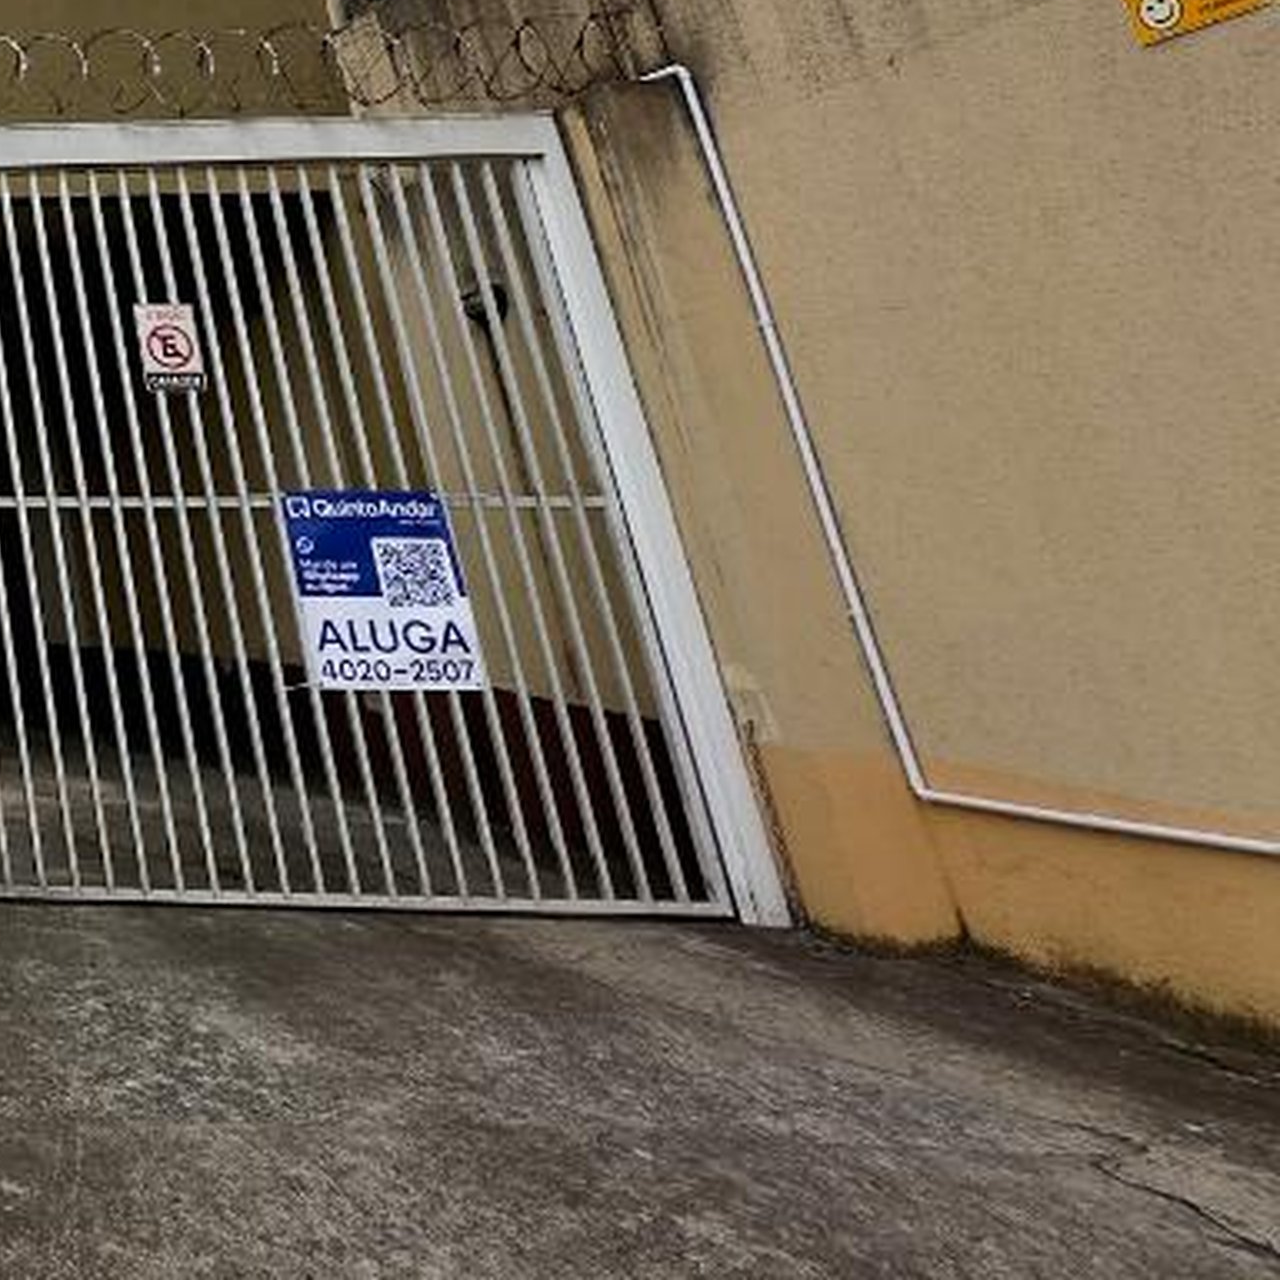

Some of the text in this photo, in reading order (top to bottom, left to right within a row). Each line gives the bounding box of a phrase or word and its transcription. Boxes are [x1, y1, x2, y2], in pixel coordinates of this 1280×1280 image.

[161, 334, 178, 358] E
[312, 498, 438, 519] QuintoAndar
[317, 619, 472, 654] ALUGA
[321, 658, 475, 682] 4020-2507
